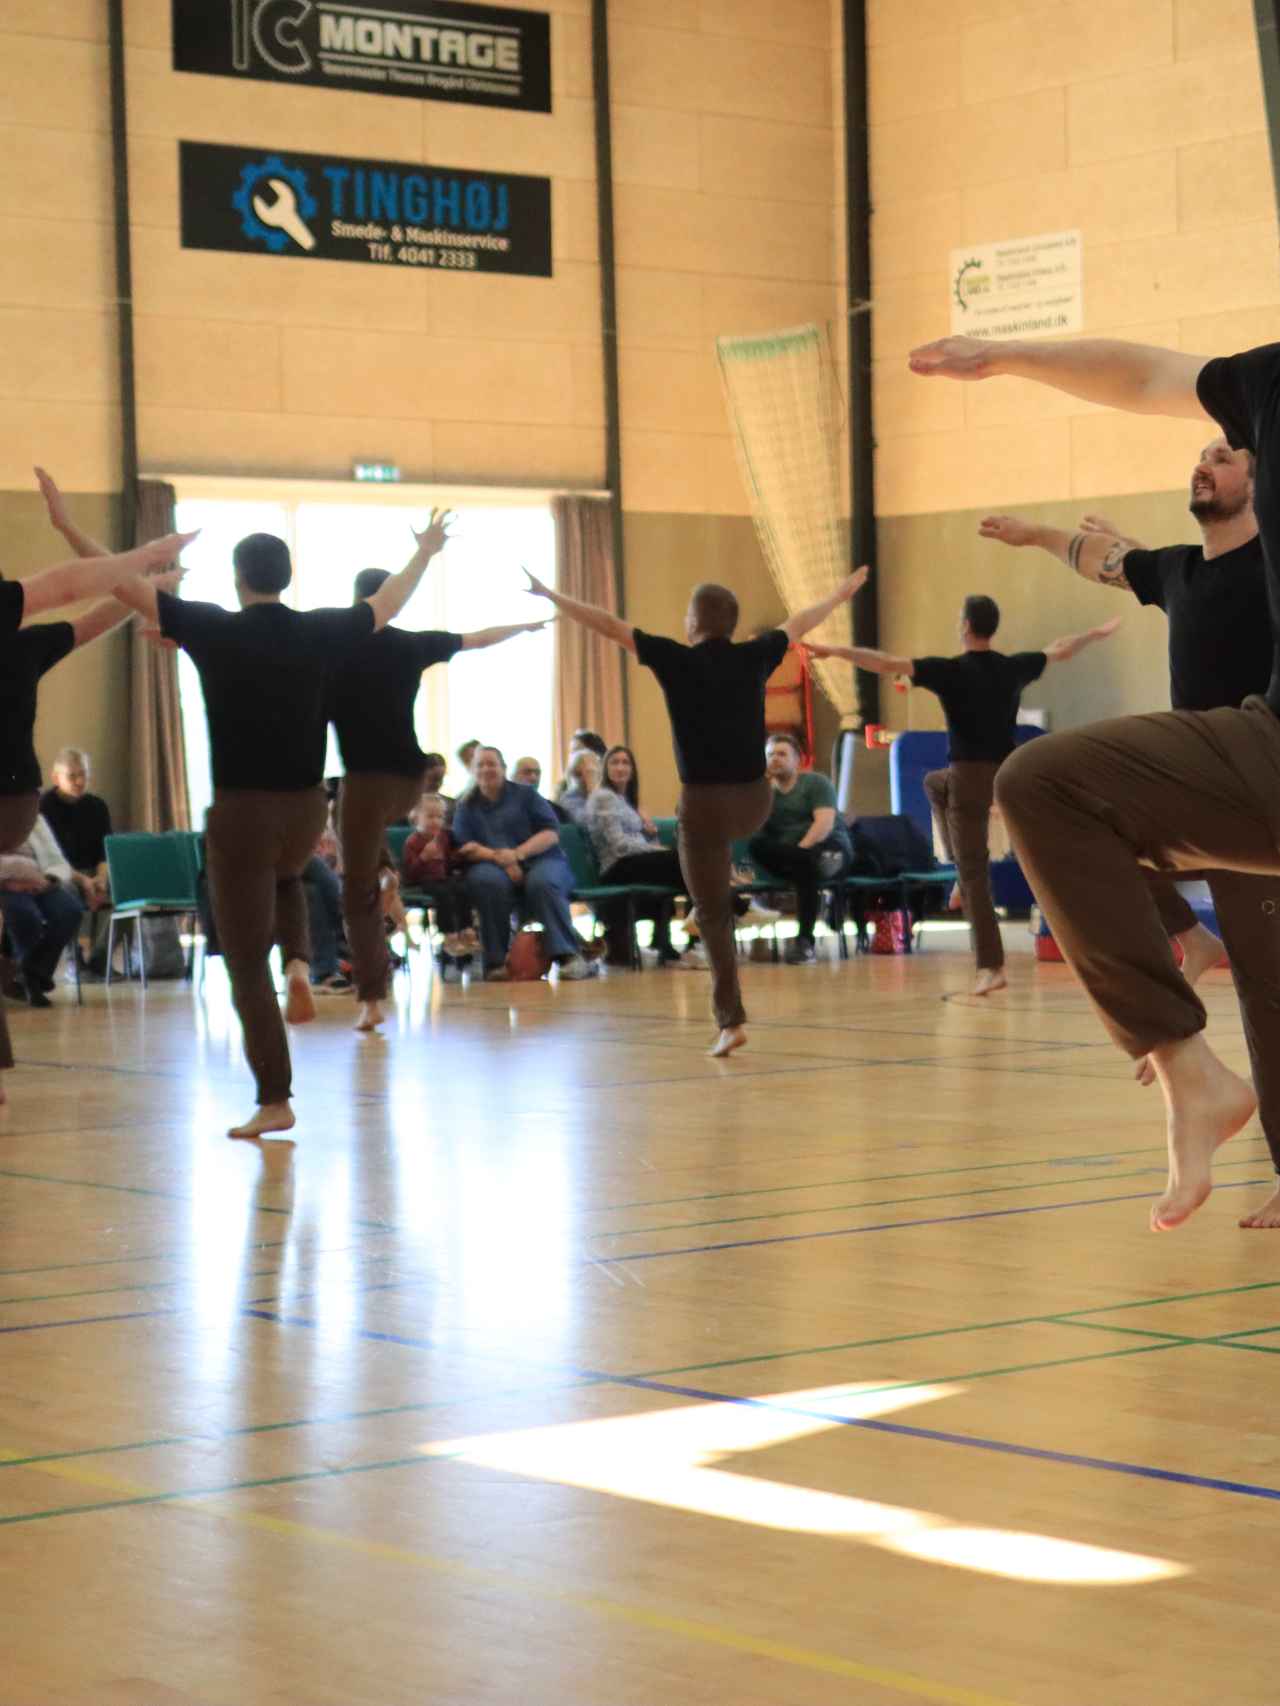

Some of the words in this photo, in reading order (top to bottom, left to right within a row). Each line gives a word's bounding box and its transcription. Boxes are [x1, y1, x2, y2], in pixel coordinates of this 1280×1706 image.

[319, 13, 520, 72] MONTAGE
[322, 165, 510, 231] TINGHØJ
[330, 219, 386, 240] Smede-
[390, 225, 404, 242] &
[405, 226, 511, 252] Maskinservice
[398, 247, 435, 266] 4041
[439, 250, 477, 270] 2333
